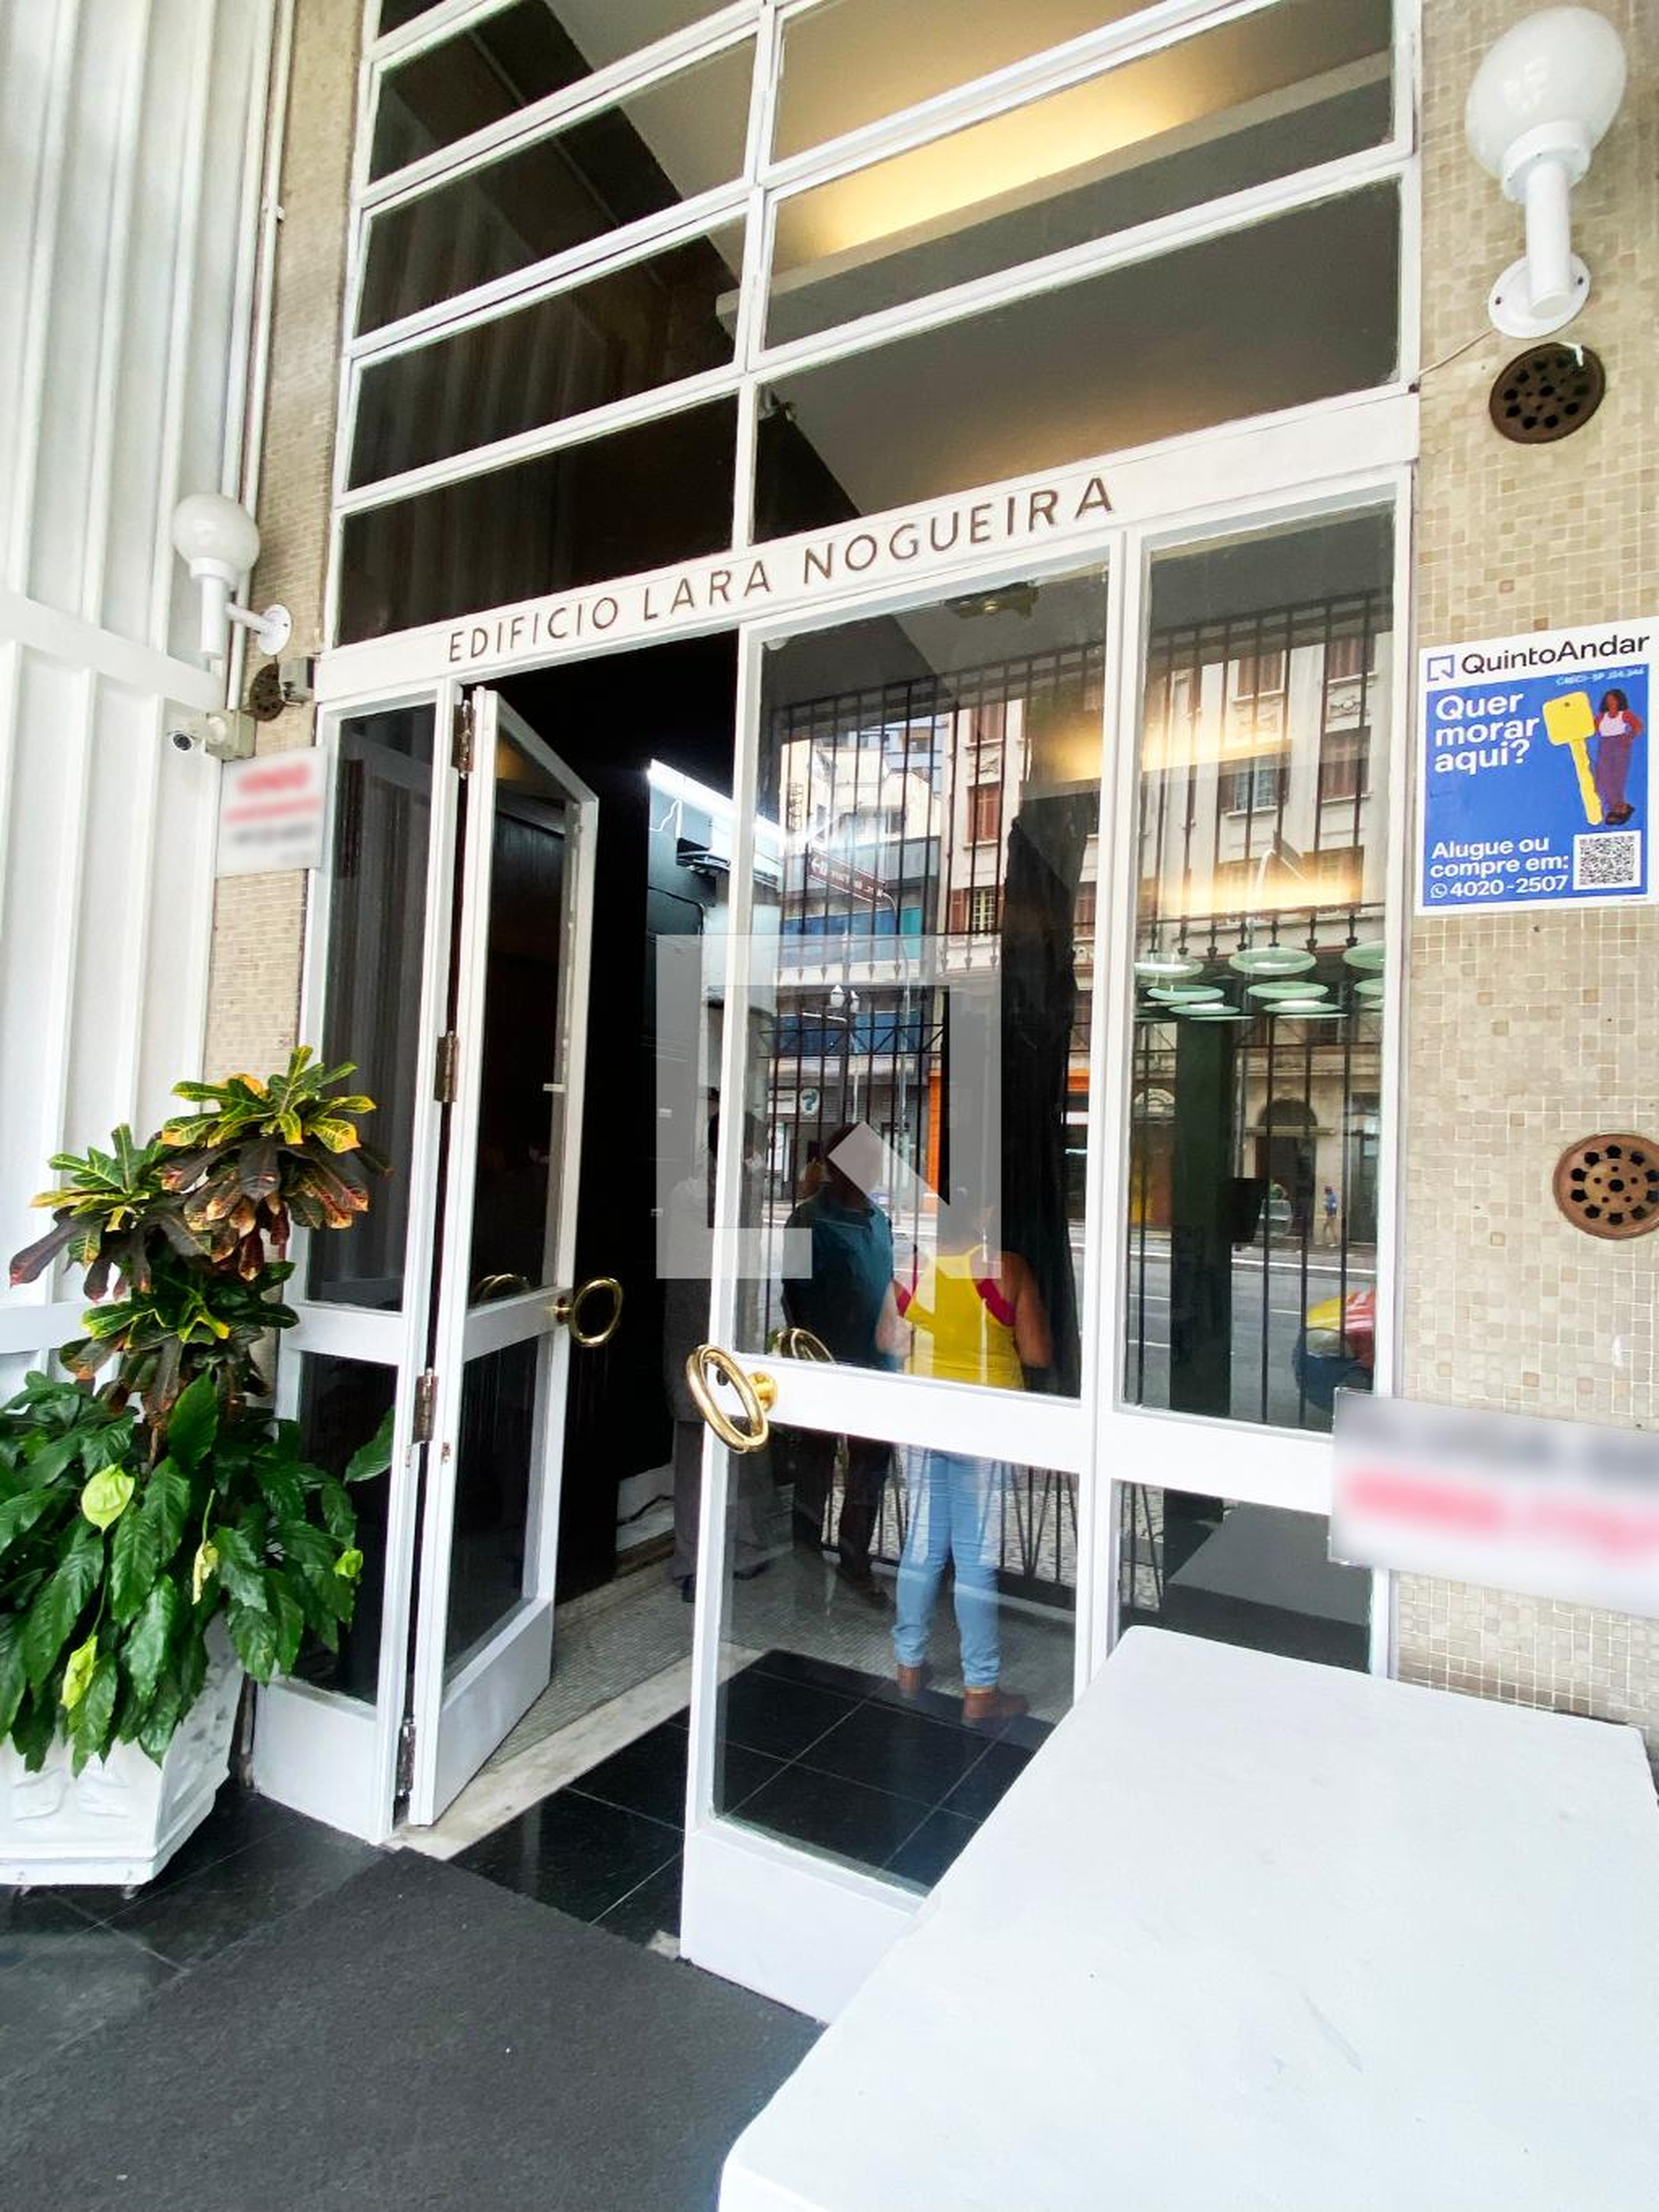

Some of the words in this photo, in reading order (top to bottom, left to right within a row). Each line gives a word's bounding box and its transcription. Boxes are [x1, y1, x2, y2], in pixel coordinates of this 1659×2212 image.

[449, 598, 618, 662] EDIFICIO
[644, 560, 770, 621] LARA
[804, 477, 1113, 584] NOGUEIRA
[1462, 635, 1650, 674] QuintoAndar
[1436, 693, 1523, 720] Quer
[1436, 718, 1540, 746] morar
[1435, 739, 1530, 775] aqui?
[1431, 840, 1514, 860] Alugue
[1519, 837, 1549, 853] ou
[1430, 859, 1519, 878] compre
[1526, 855, 1569, 871] em:
